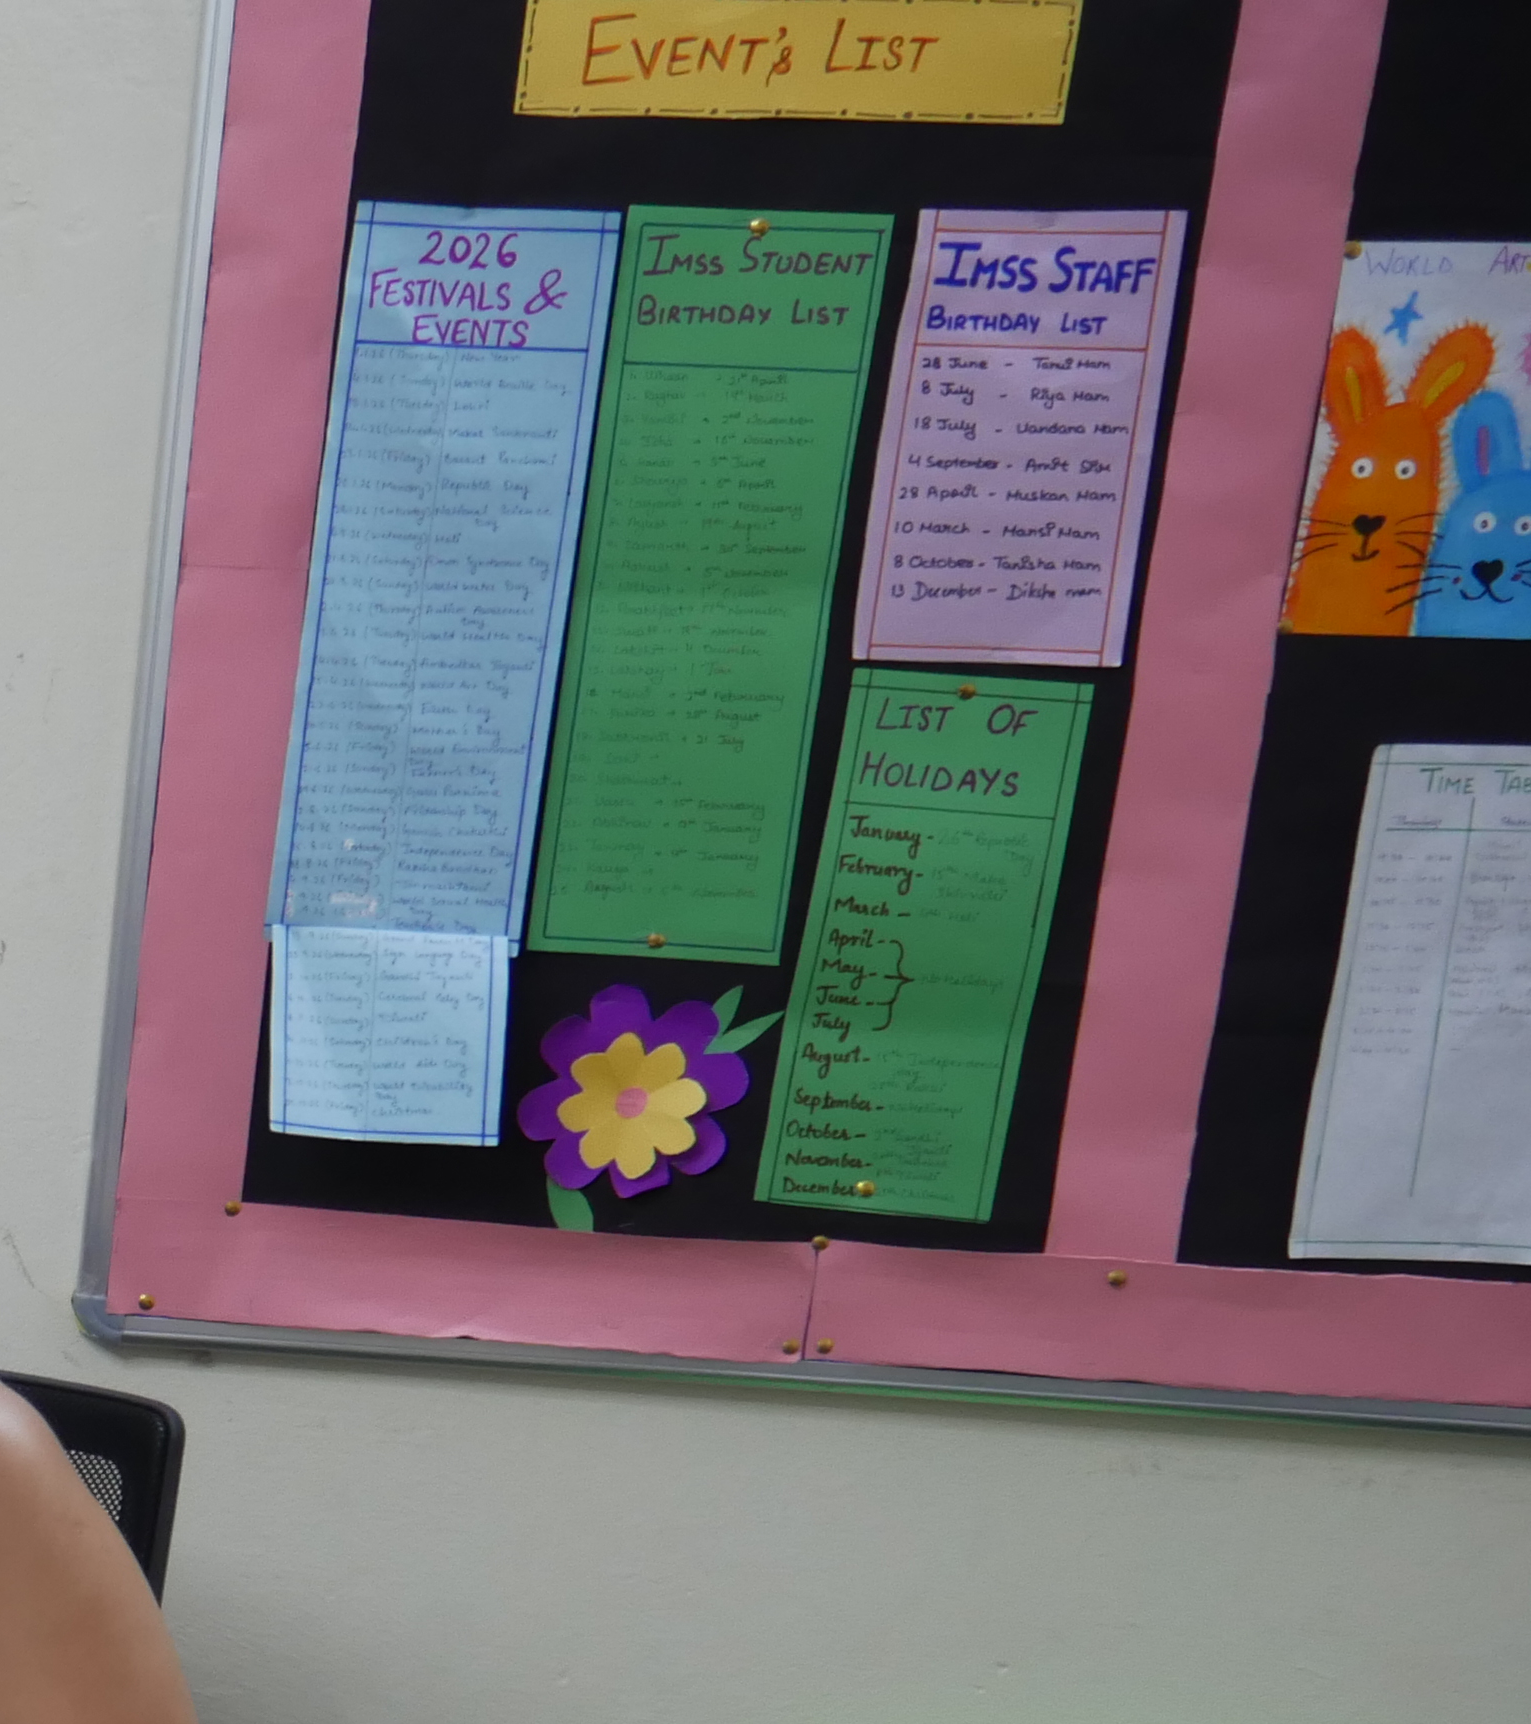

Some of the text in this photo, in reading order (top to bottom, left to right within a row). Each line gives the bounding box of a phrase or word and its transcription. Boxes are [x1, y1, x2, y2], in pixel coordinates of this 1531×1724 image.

[825, 17, 940, 74] LIST
[418, 230, 519, 269] 2026
[643, 234, 874, 276] IMSS STUDENT
[1365, 248, 1454, 276] WORLD
[933, 242, 1157, 294] IMSS STAFF
[369, 267, 568, 315] FESTIVALS &
[637, 294, 850, 325] BIRTHDAY LIST
[926, 305, 1107, 335] BIRTHDAY LIST
[411, 314, 530, 348] EVENTS
[922, 357, 941, 369] 28
[949, 358, 988, 370] June
[921, 381, 931, 395] 8
[940, 382, 975, 406] July
[1030, 387, 1065, 410] Riya
[914, 416, 931, 429] 18
[937, 418, 977, 440] July
[908, 455, 921, 468] 4
[925, 456, 999, 476] September
[898, 487, 919, 500] 28
[894, 521, 914, 534] 10
[919, 522, 971, 535] March
[893, 555, 903, 568] 8
[993, 555, 1056, 571] Tanisha
[875, 697, 1040, 736] LIST OF
[859, 751, 1020, 797] HOLIDAYS
[1420, 767, 1475, 795] TIME
[849, 815, 921, 860] January
[838, 853, 914, 896] February
[834, 895, 890, 918] March
[828, 928, 874, 956] April
[820, 958, 866, 991] May
[816, 985, 861, 1006] June
[812, 1012, 851, 1042] July
[801, 1042, 860, 1079] August
[793, 1087, 871, 1115] September
[786, 1119, 851, 1141] October
[785, 1149, 863, 1169] November
